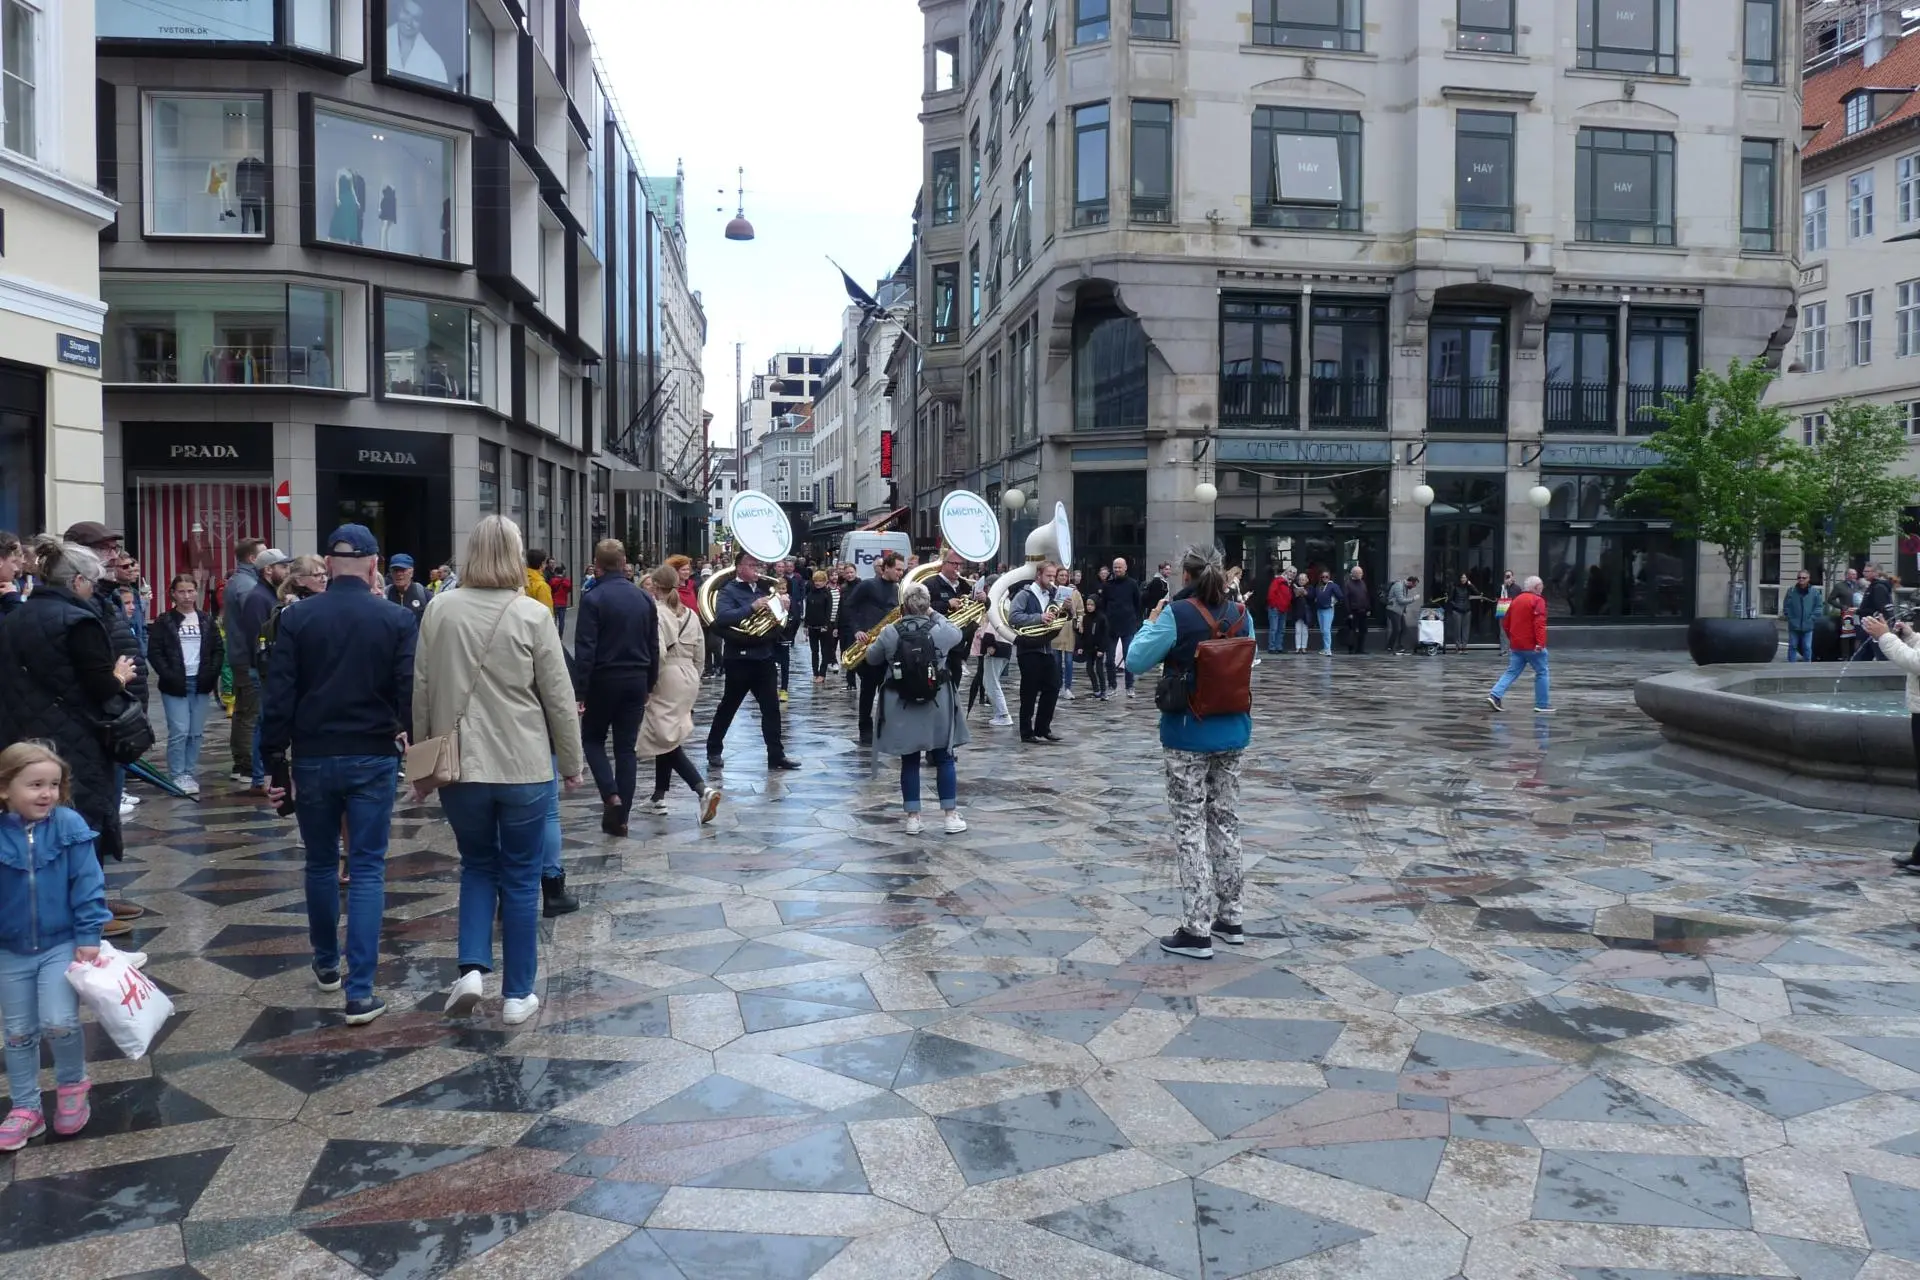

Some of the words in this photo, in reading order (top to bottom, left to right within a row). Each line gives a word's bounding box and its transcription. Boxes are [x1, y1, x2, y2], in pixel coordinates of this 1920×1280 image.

[1616, 10, 1637, 20] HAY
[1298, 162, 1319, 172] HAY
[1473, 163, 1494, 174] HAY
[1614, 182, 1633, 192] HAY
[170, 445, 239, 458] PRADA
[358, 449, 417, 465] PRADA
[737, 507, 774, 519] AMICITIA
[946, 507, 985, 517] AMICITIA
